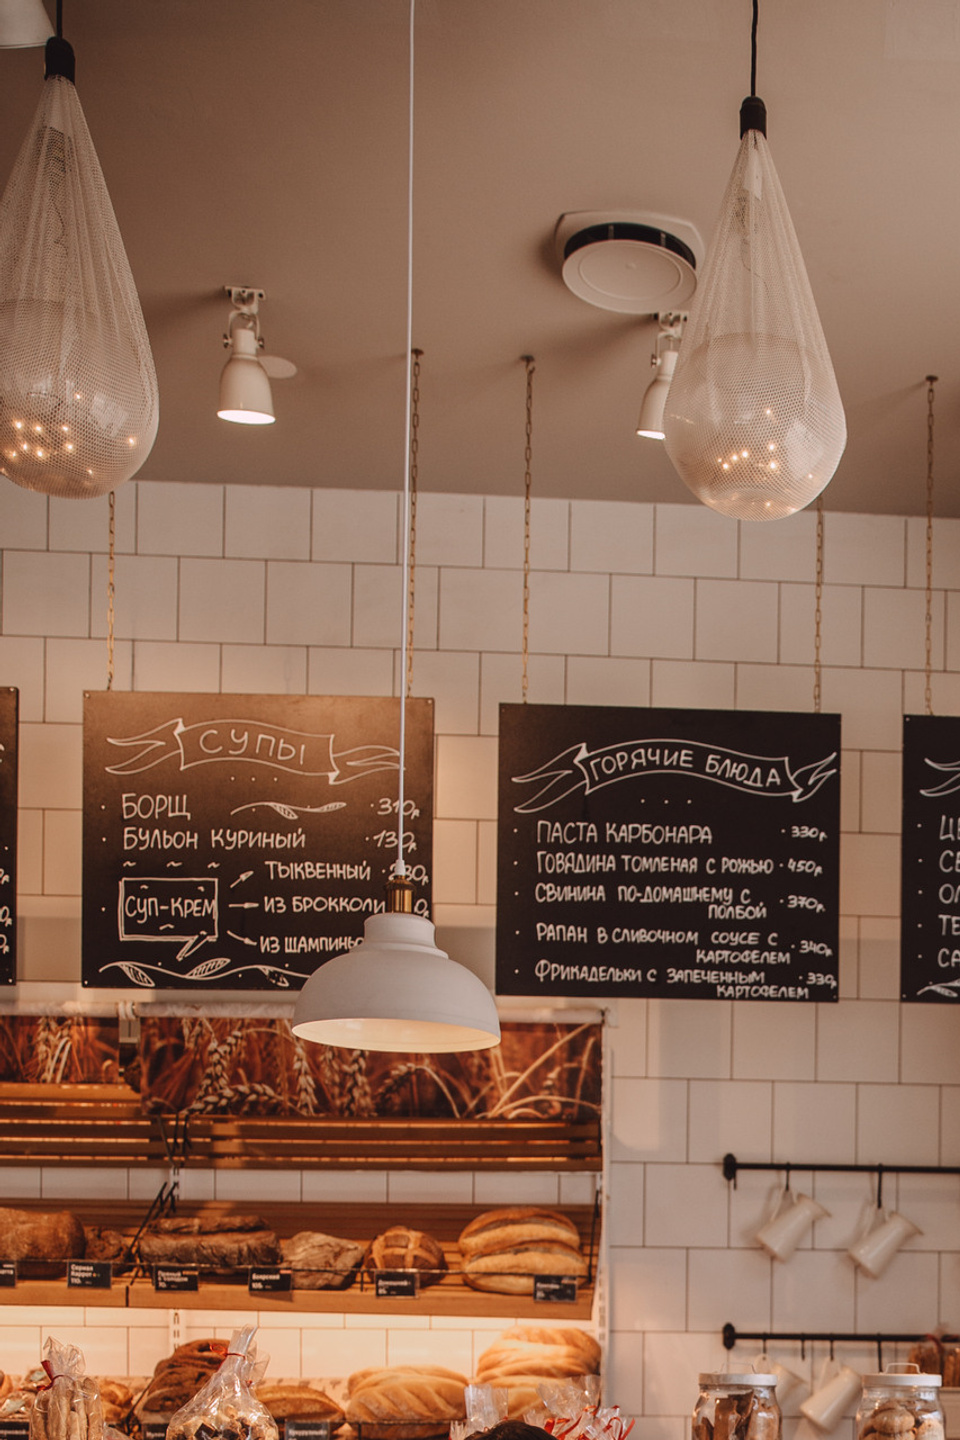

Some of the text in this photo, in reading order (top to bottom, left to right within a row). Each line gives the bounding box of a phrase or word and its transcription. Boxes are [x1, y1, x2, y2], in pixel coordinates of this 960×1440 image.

[199, 729, 306, 765] СУПЫ
[589, 748, 782, 788] ГОРЯЧИЕ БЛЮДА
[122, 793, 190, 820] БОРЩ
[124, 827, 198, 850] БУЛЬОН
[212, 828, 305, 850] КУРИНЫЙ
[538, 820, 597, 844] ПАСТА
[606, 823, 712, 844] КАРБОНАРА
[265, 861, 370, 880] ТЫКВЕННЫЙ
[537, 851, 615, 873] ГОВЯДИНА
[621, 855, 697, 873] ТОМЛЕНАЯ
[706, 858, 716, 874] С
[722, 857, 773, 874] РОЖЬЮ
[264, 896, 286, 913] ИЗ
[292, 896, 387, 915] БРОККОЛИ
[535, 883, 605, 902] СВИНИНА
[618, 886, 732, 905] ПО-ДОМАШНЕМУ
[741, 889, 750, 904] С
[125, 896, 215, 923] СУП-КРЕМ
[709, 903, 766, 919] ПОЛБОЙ
[260, 936, 365, 954] ИЗ ШАМПИНЬО
[536, 923, 587, 942] РАПАН
[597, 927, 608, 943] В
[612, 928, 698, 944] СЛИВОЧНОМ
[711, 932, 760, 945] СОУСЕ
[768, 933, 778, 946] С
[696, 949, 790, 964] КАРТОФЕЛЕМ
[535, 960, 641, 982] ФРИКАДЕЛЬКИ
[647, 969, 657, 982] С
[667, 968, 764, 984] ЗАПЕЧЕННЫМ
[717, 985, 808, 998] КАРТОФЕЛЕМ
